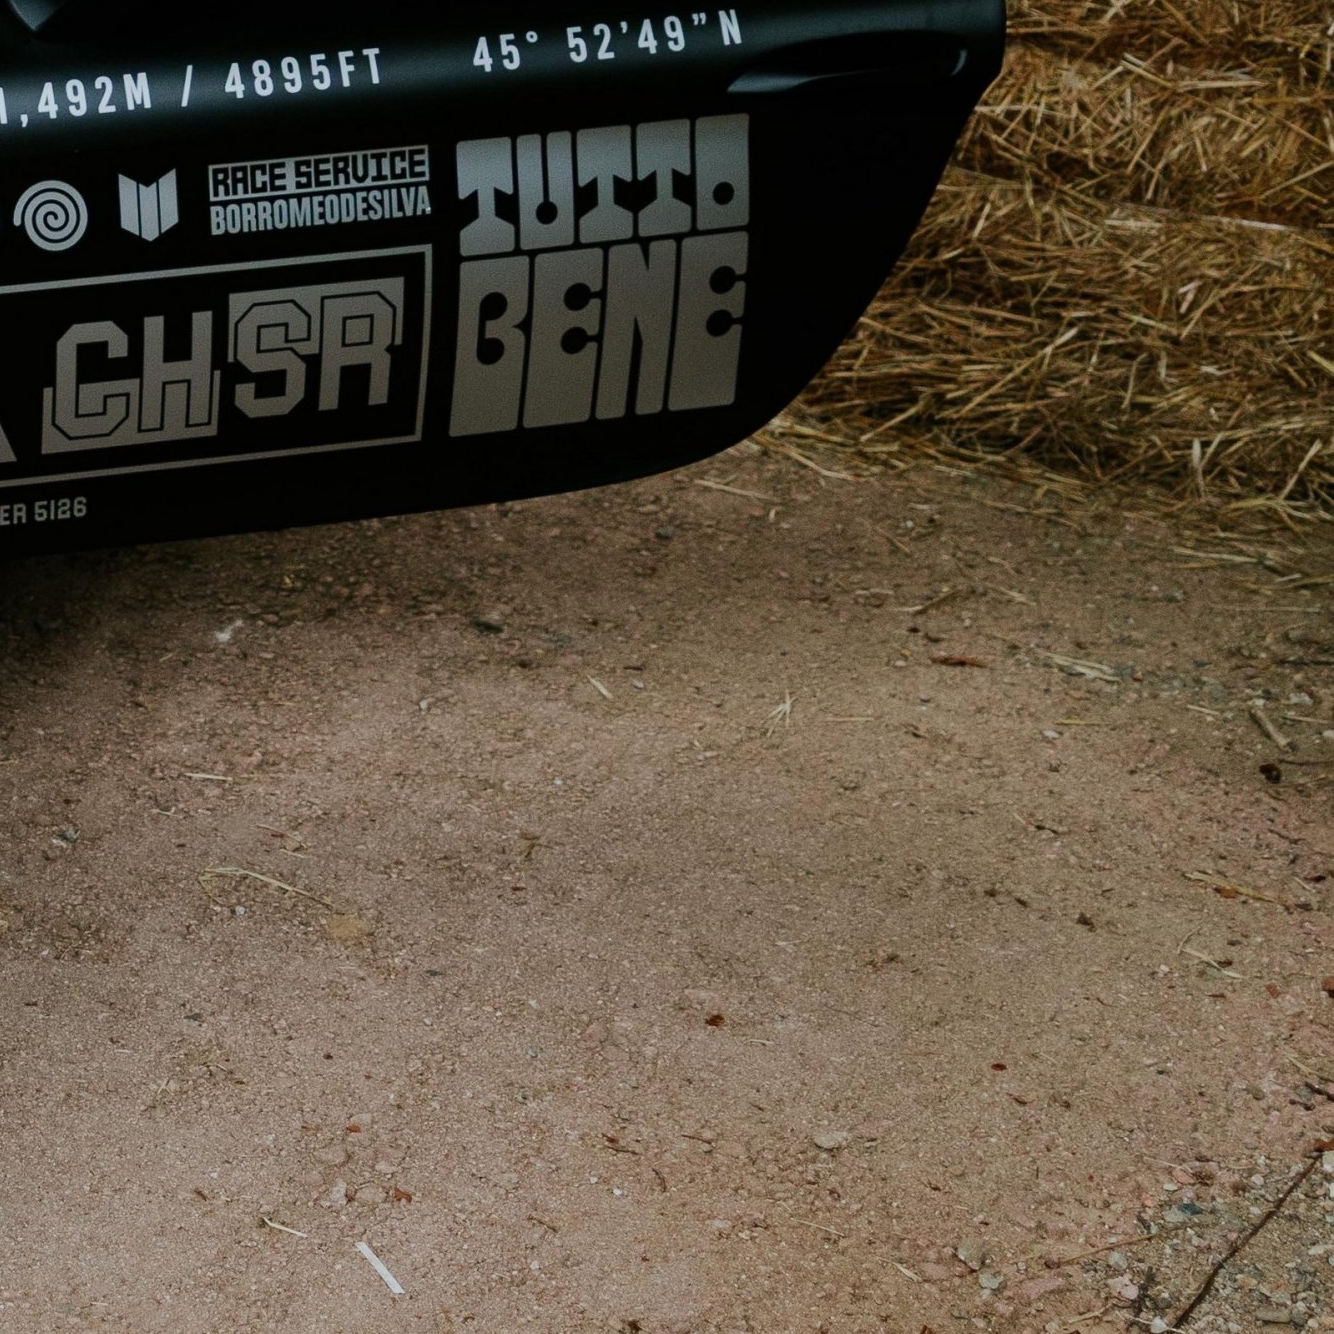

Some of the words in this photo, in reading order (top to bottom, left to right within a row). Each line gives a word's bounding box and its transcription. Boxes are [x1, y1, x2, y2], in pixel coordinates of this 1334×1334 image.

[224, 47, 381, 99] 4895FT
[472, 29, 539, 72] 45°
[211, 154, 289, 199] RACE
[294, 147, 427, 190] SERVICE
[455, 112, 750, 258] TUTTO
[210, 185, 432, 236] BORROMEODESILVA
[448, 230, 750, 437] BENE
[34, 497, 88, 521] 5126
